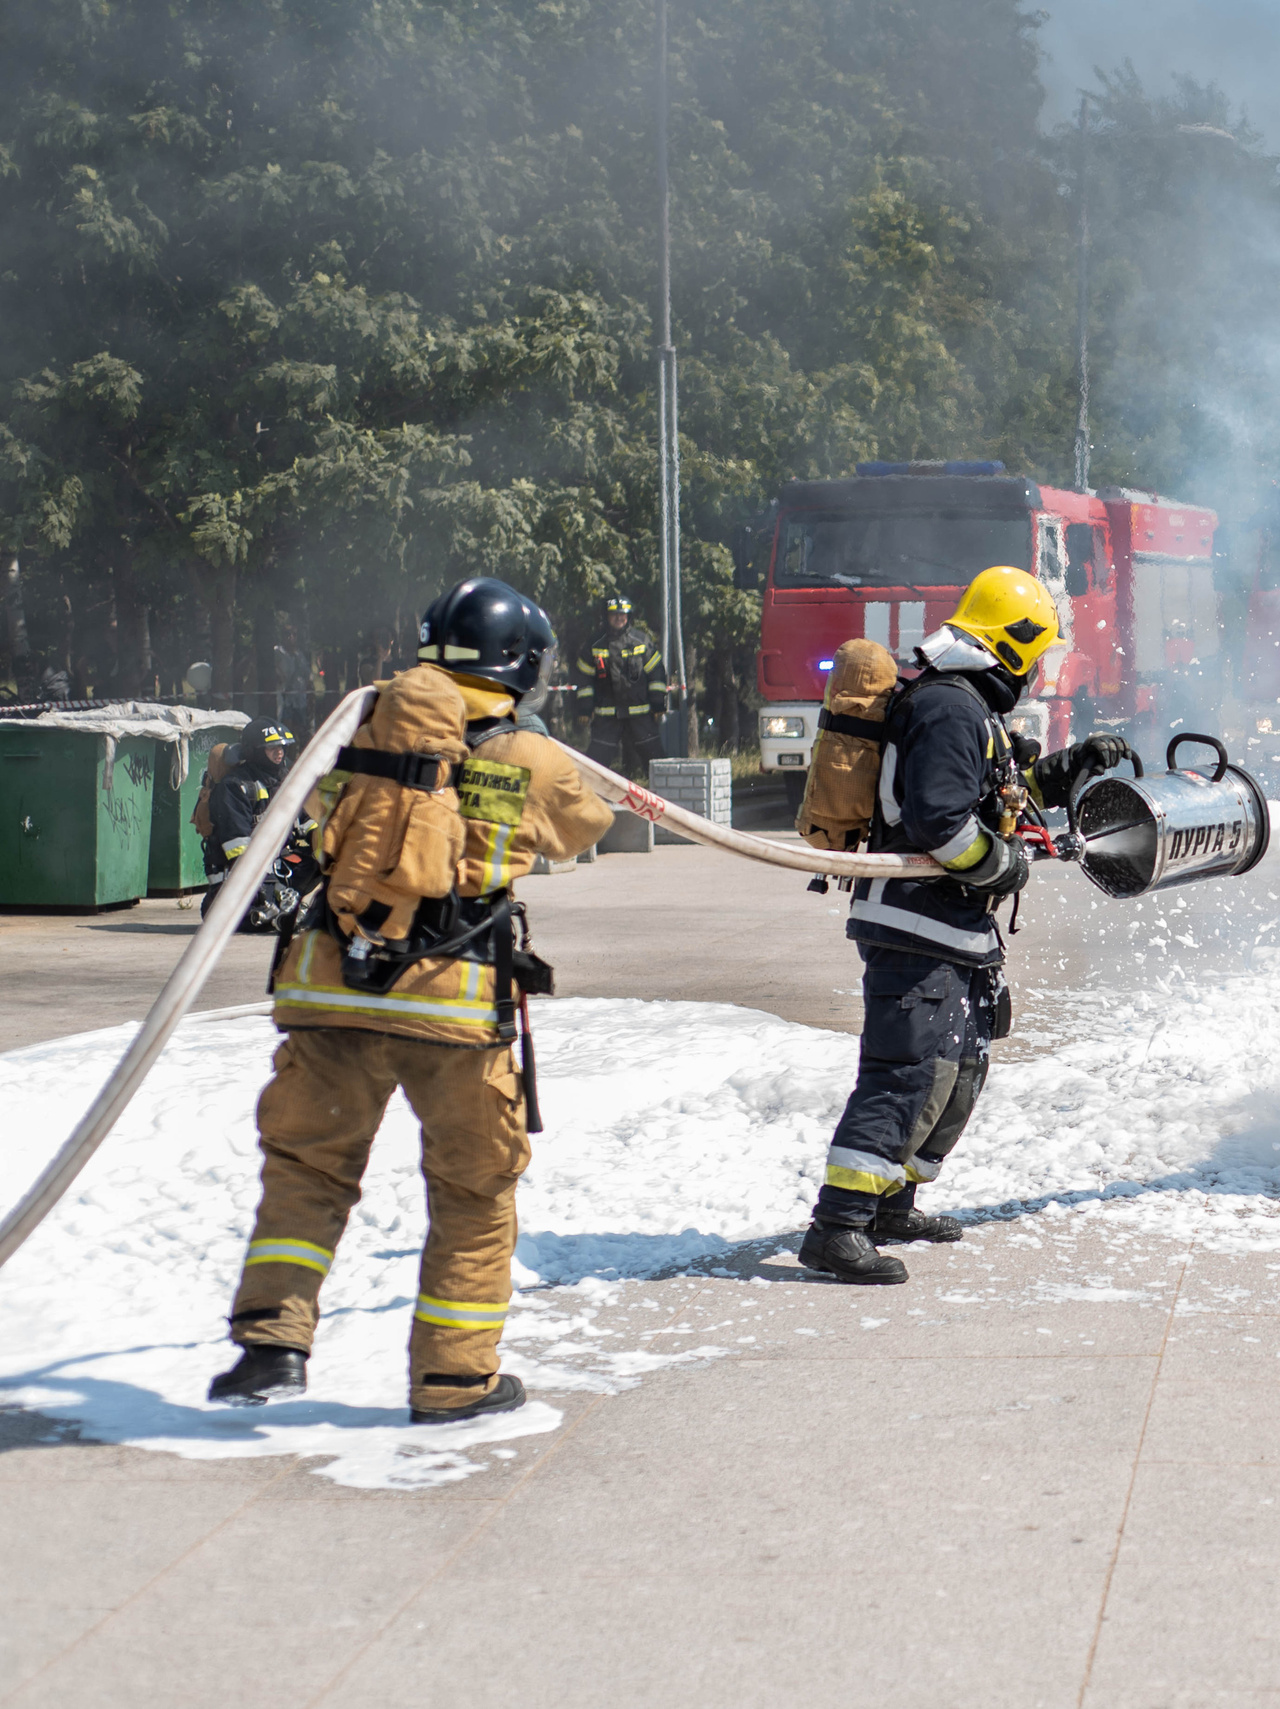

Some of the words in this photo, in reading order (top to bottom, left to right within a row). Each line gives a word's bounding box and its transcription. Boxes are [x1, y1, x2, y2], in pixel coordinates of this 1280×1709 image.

[261, 726, 276, 736] 76
[462, 769, 520, 793] СЛУЖБА
[1168, 823, 1225, 860] ПУРГА
[1229, 820, 1242, 849] 5
